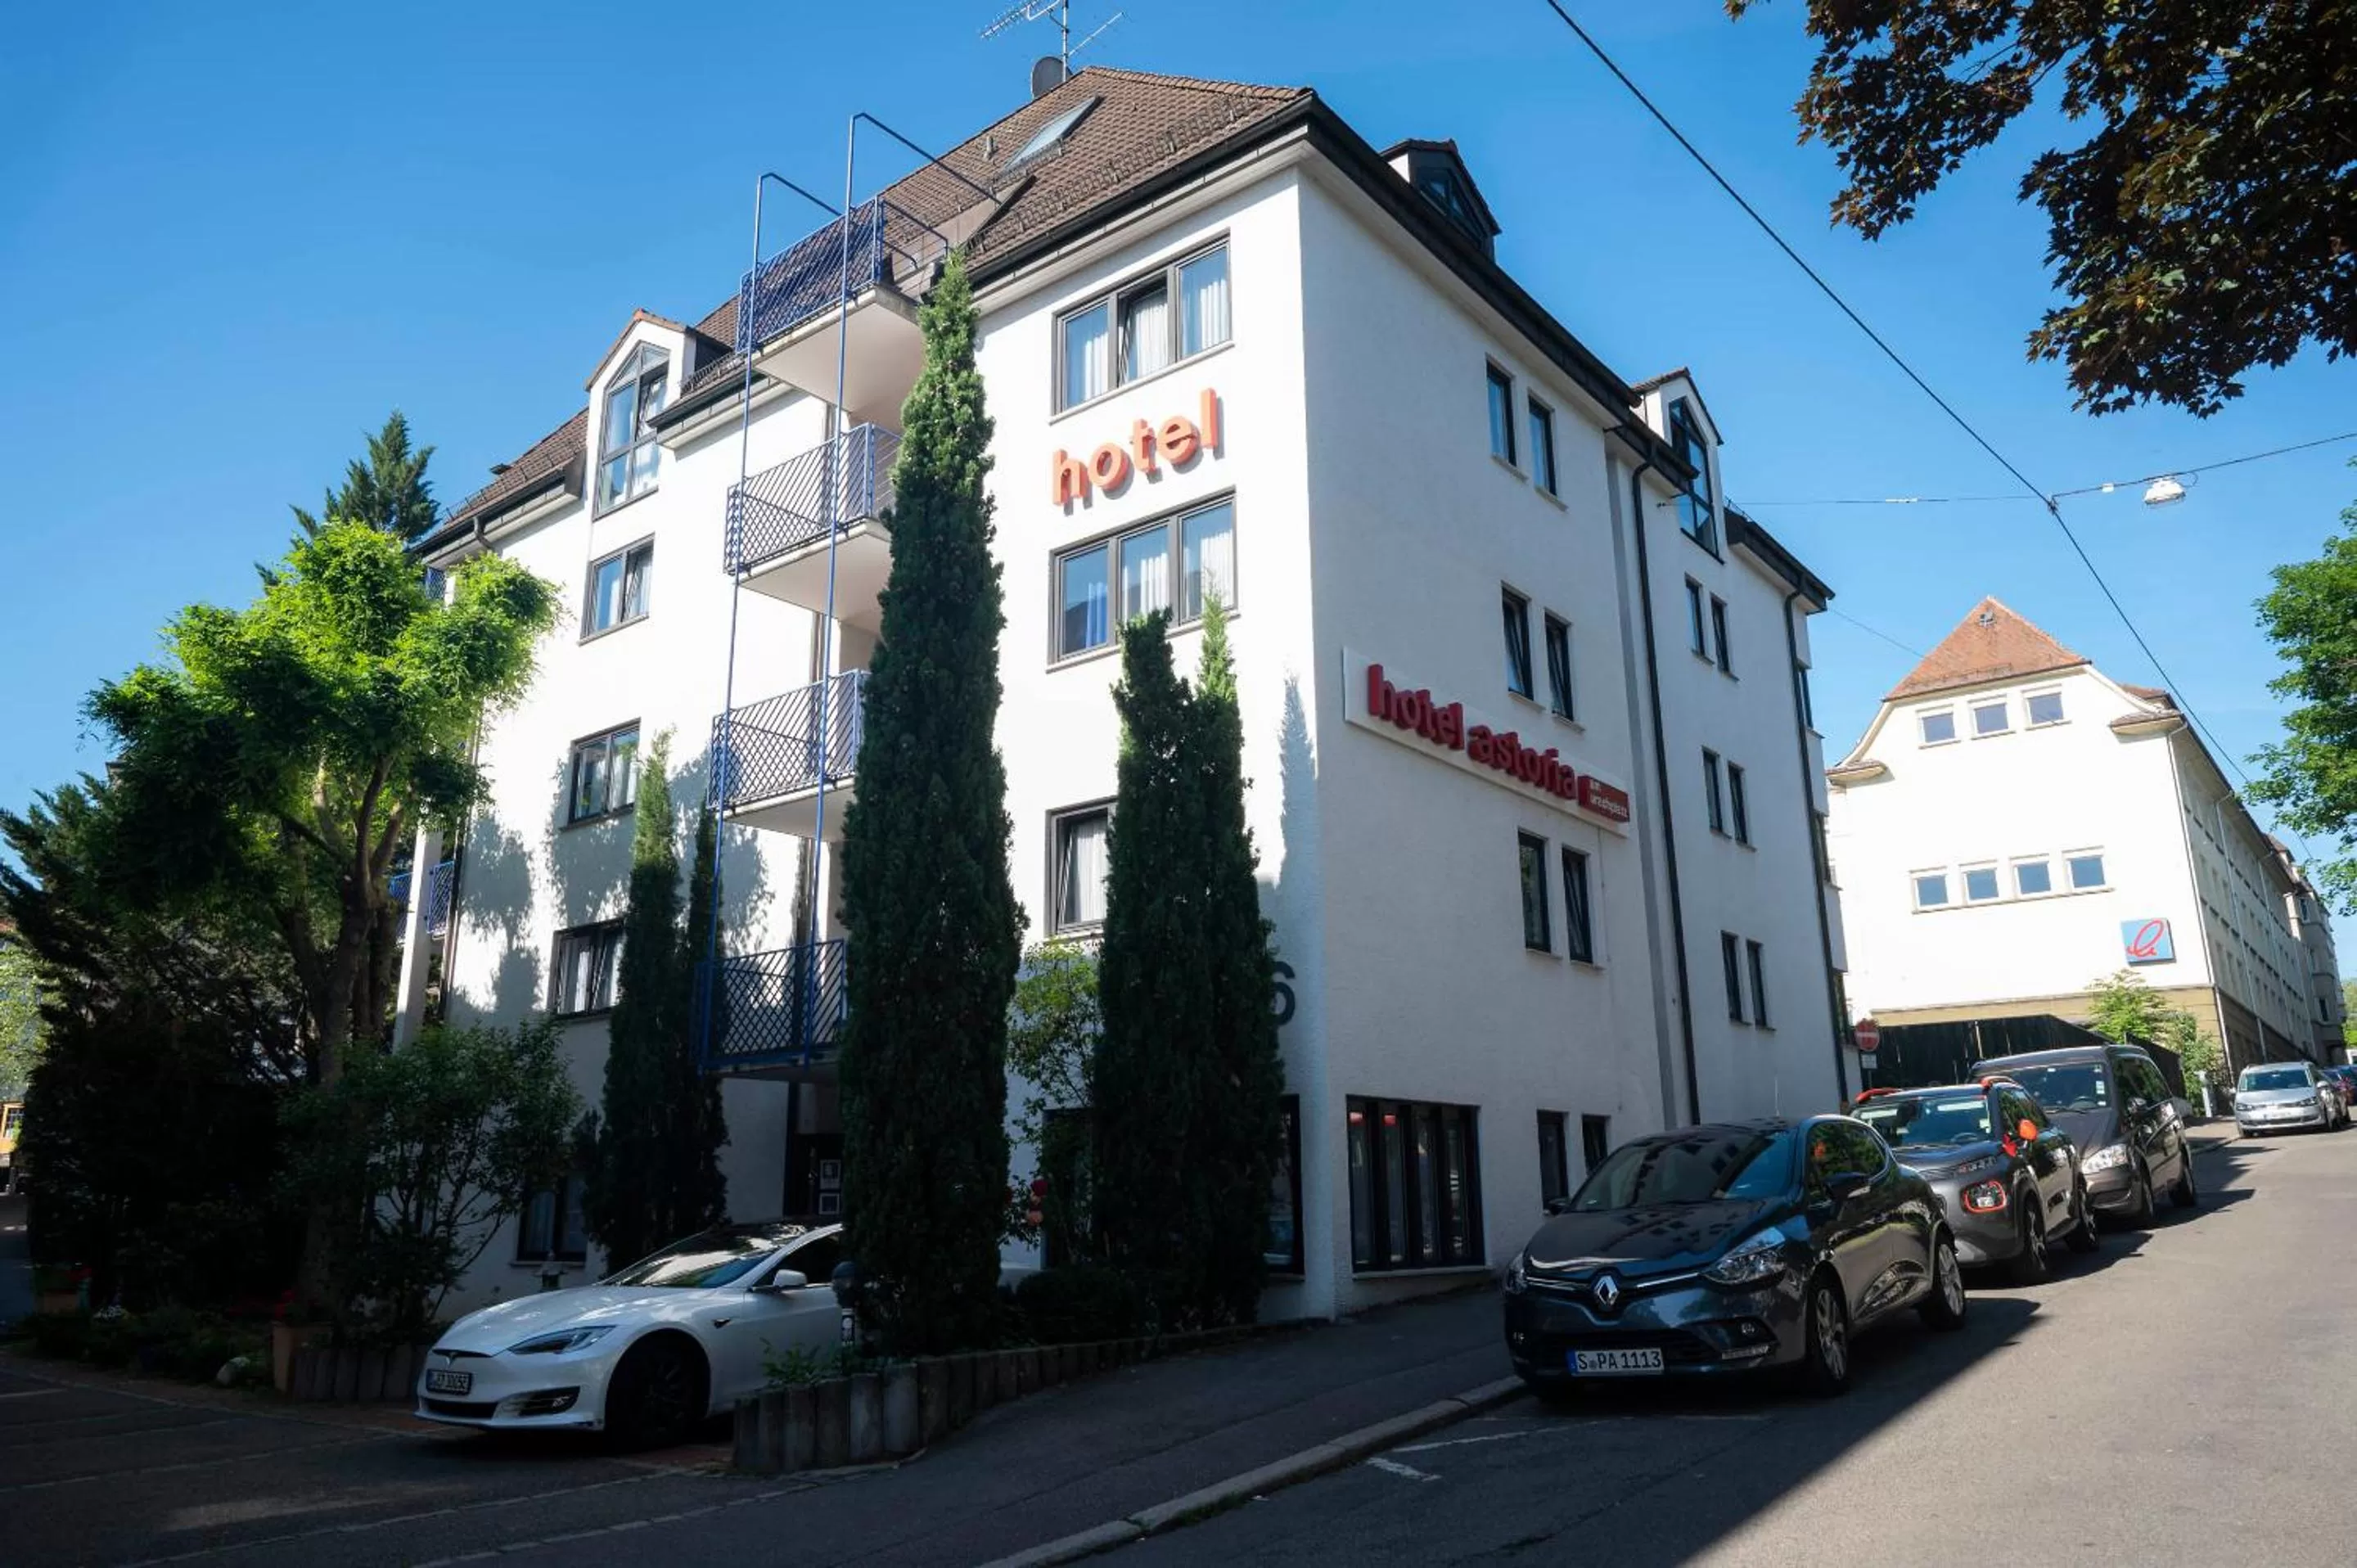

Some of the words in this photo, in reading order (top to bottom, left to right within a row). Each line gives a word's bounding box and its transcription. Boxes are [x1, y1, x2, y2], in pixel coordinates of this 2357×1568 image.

[1052, 387, 1217, 506] hotel
[1368, 664, 1464, 750] hotel
[1467, 724, 1575, 800] astoria
